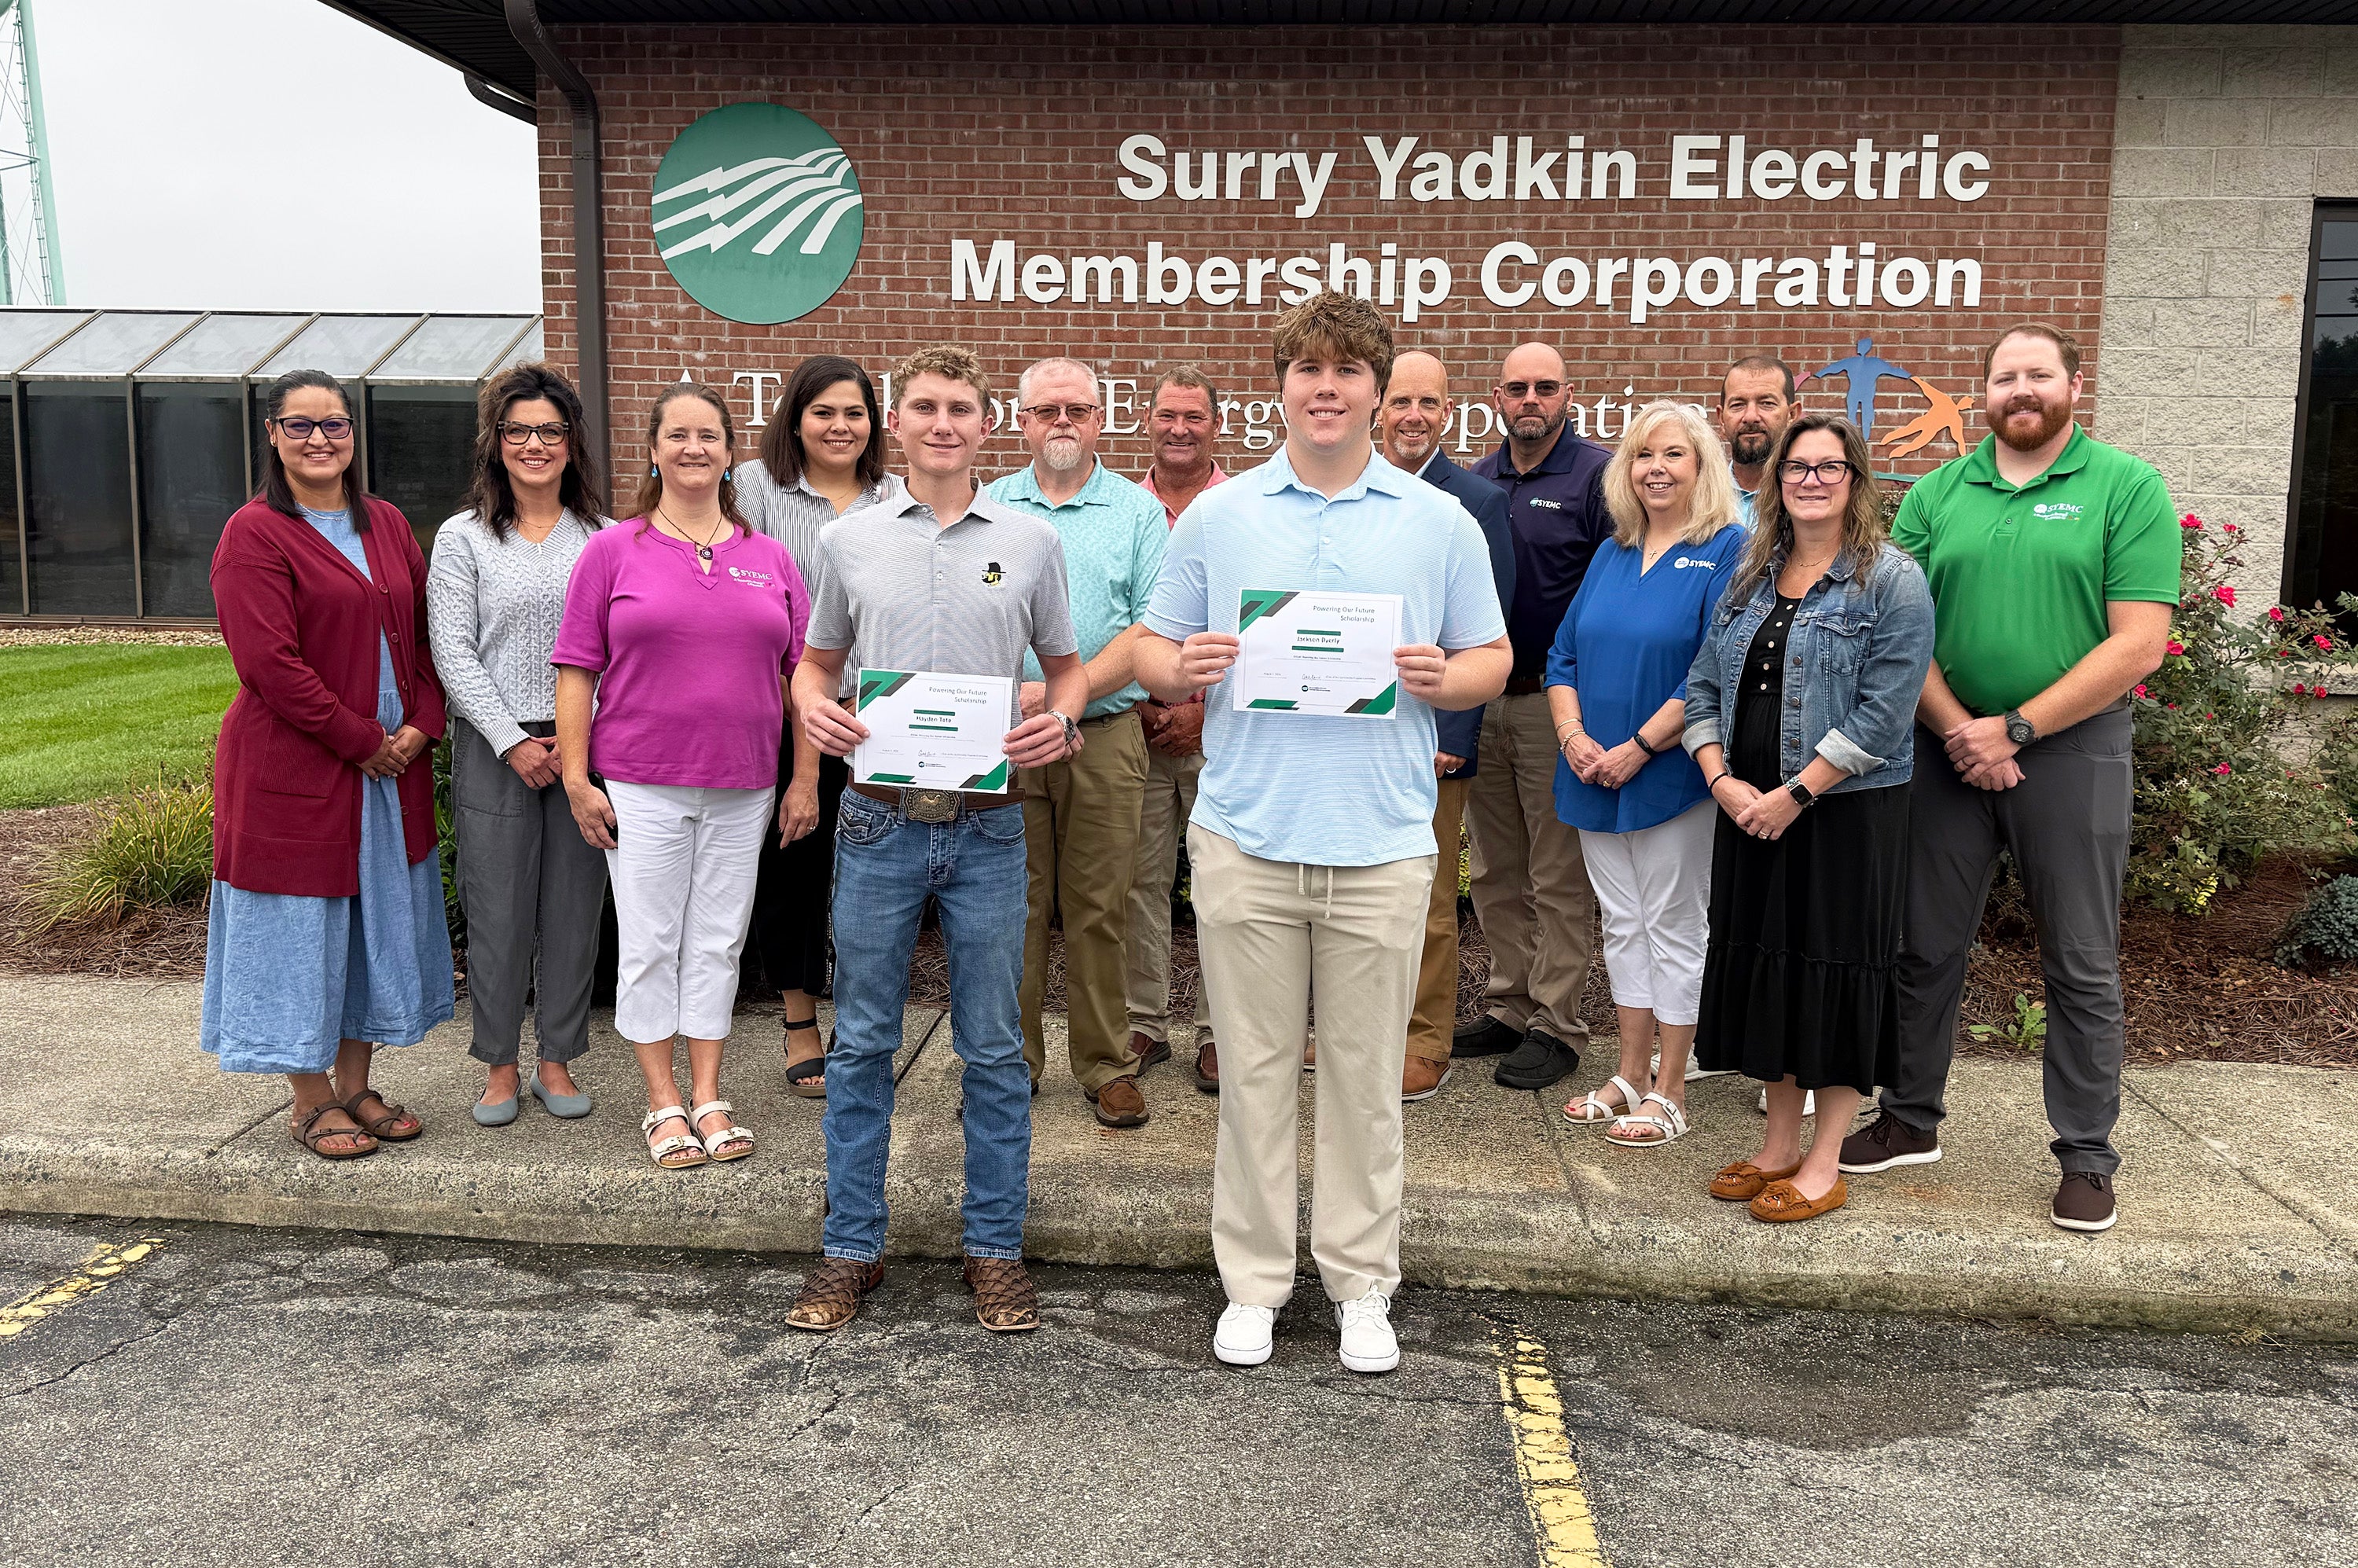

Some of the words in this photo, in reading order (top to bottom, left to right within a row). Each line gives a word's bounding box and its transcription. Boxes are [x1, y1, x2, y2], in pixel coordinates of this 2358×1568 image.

[1116, 134, 1339, 219] Surry
[1362, 134, 1637, 202] Yadkin
[1669, 134, 1991, 202] Electric
[950, 238, 1453, 323] Membership
[1479, 241, 1983, 325] Corporation
[1537, 499, 1562, 509] SYEMC
[2048, 503, 2084, 513] SYEMC
[1689, 560, 1717, 571] SYEMC
[740, 569, 773, 580] SYEMC
[929, 686, 955, 695] Powering
